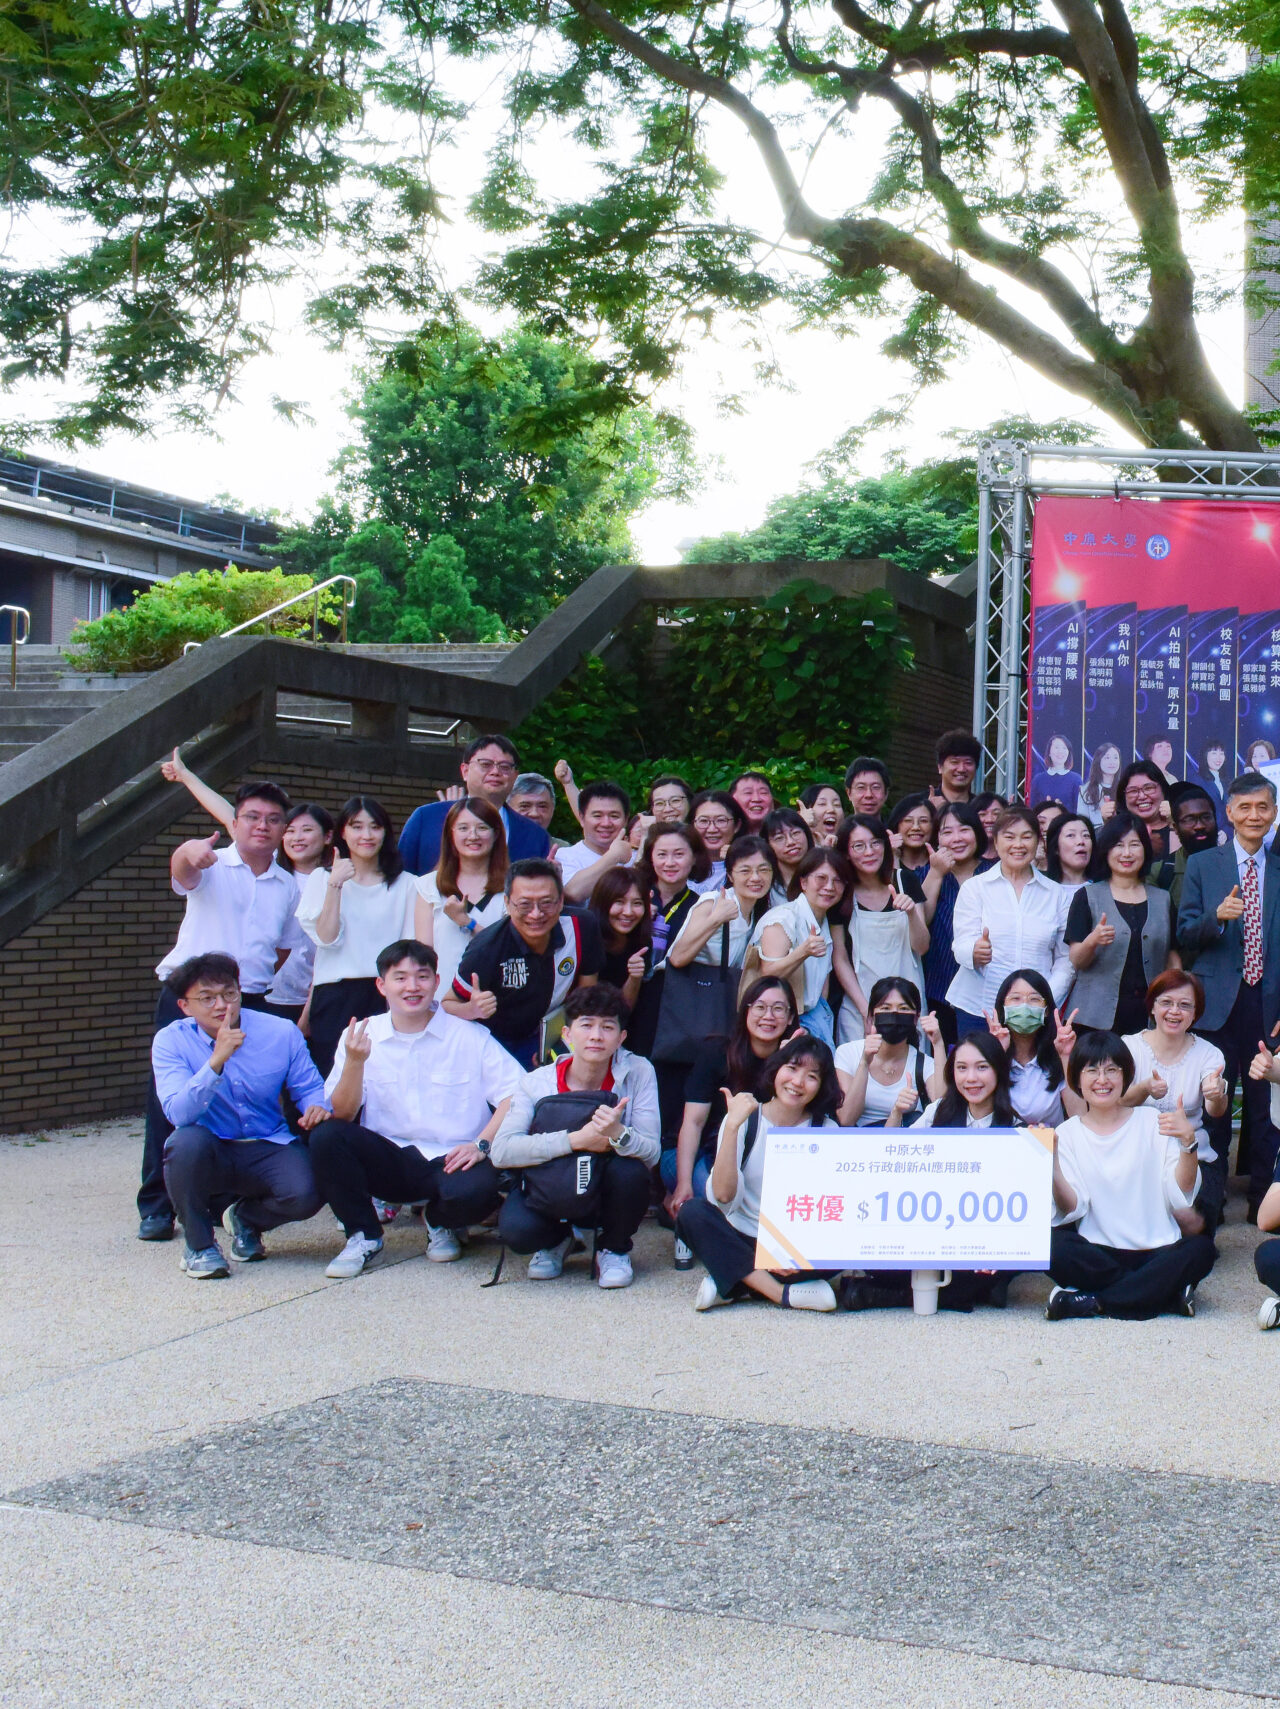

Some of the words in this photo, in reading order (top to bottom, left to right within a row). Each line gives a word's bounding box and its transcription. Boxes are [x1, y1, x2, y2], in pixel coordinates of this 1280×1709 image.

[1117, 622, 1130, 667] 我AI你
[1219, 627, 1233, 701] 校友智創團
[885, 1143, 935, 1157] 中原大學
[835, 1161, 865, 1174] 2025
[868, 1160, 982, 1174] 行政創新AI應用競賽
[786, 1194, 845, 1222] 特優
